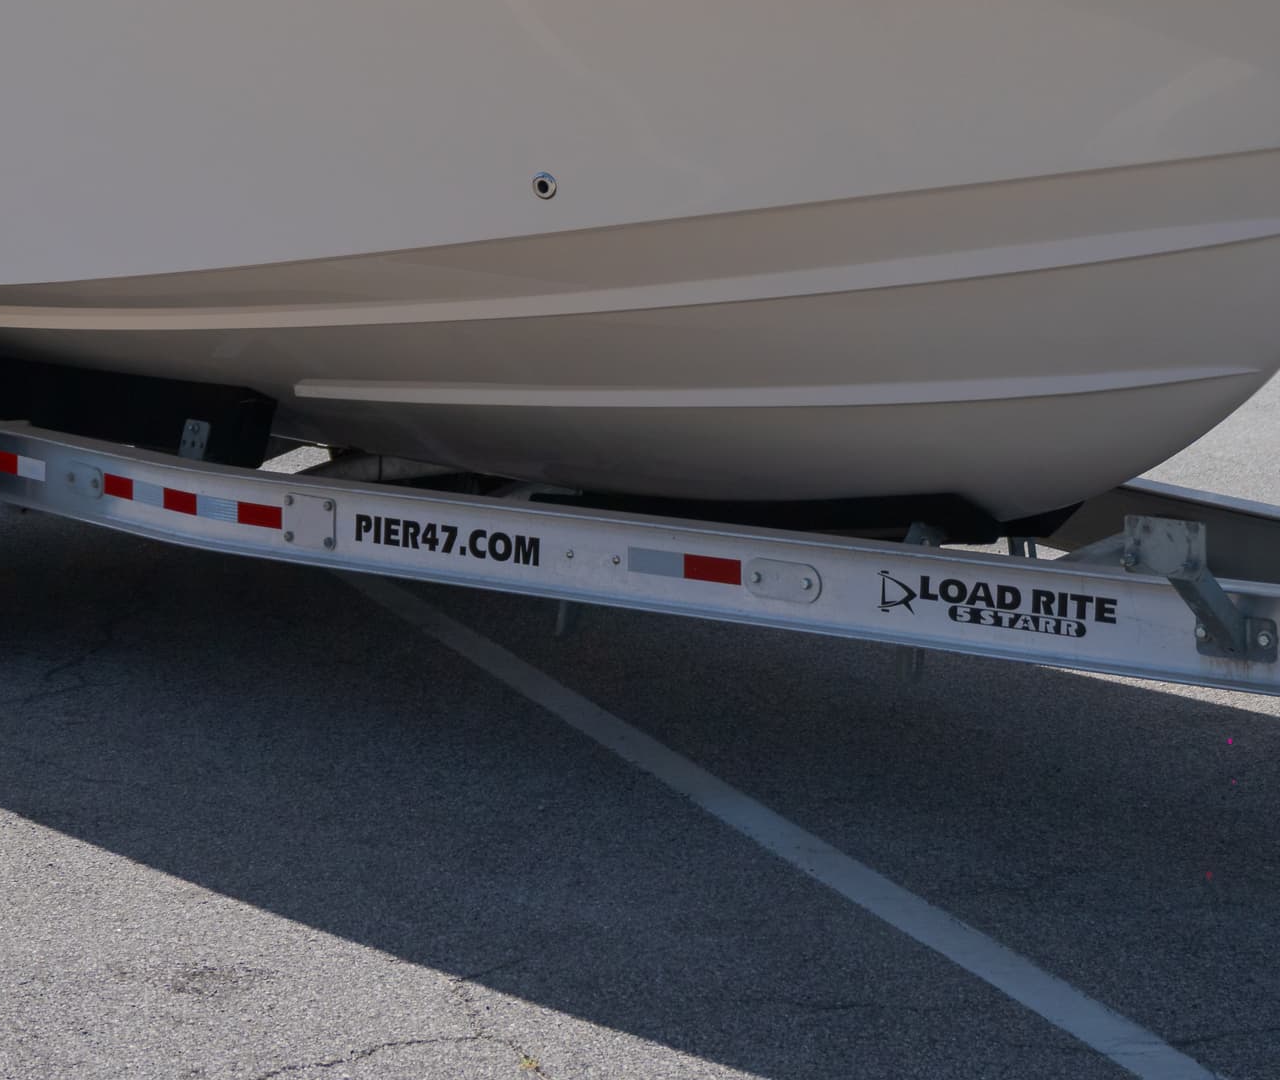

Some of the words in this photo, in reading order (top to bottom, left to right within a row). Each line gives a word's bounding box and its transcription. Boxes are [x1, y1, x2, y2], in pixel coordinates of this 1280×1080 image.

[355, 514, 540, 566] PIER47.COM
[920, 575, 1021, 610] LOAD
[1032, 589, 1117, 624] RITE
[955, 605, 972, 622] 5
